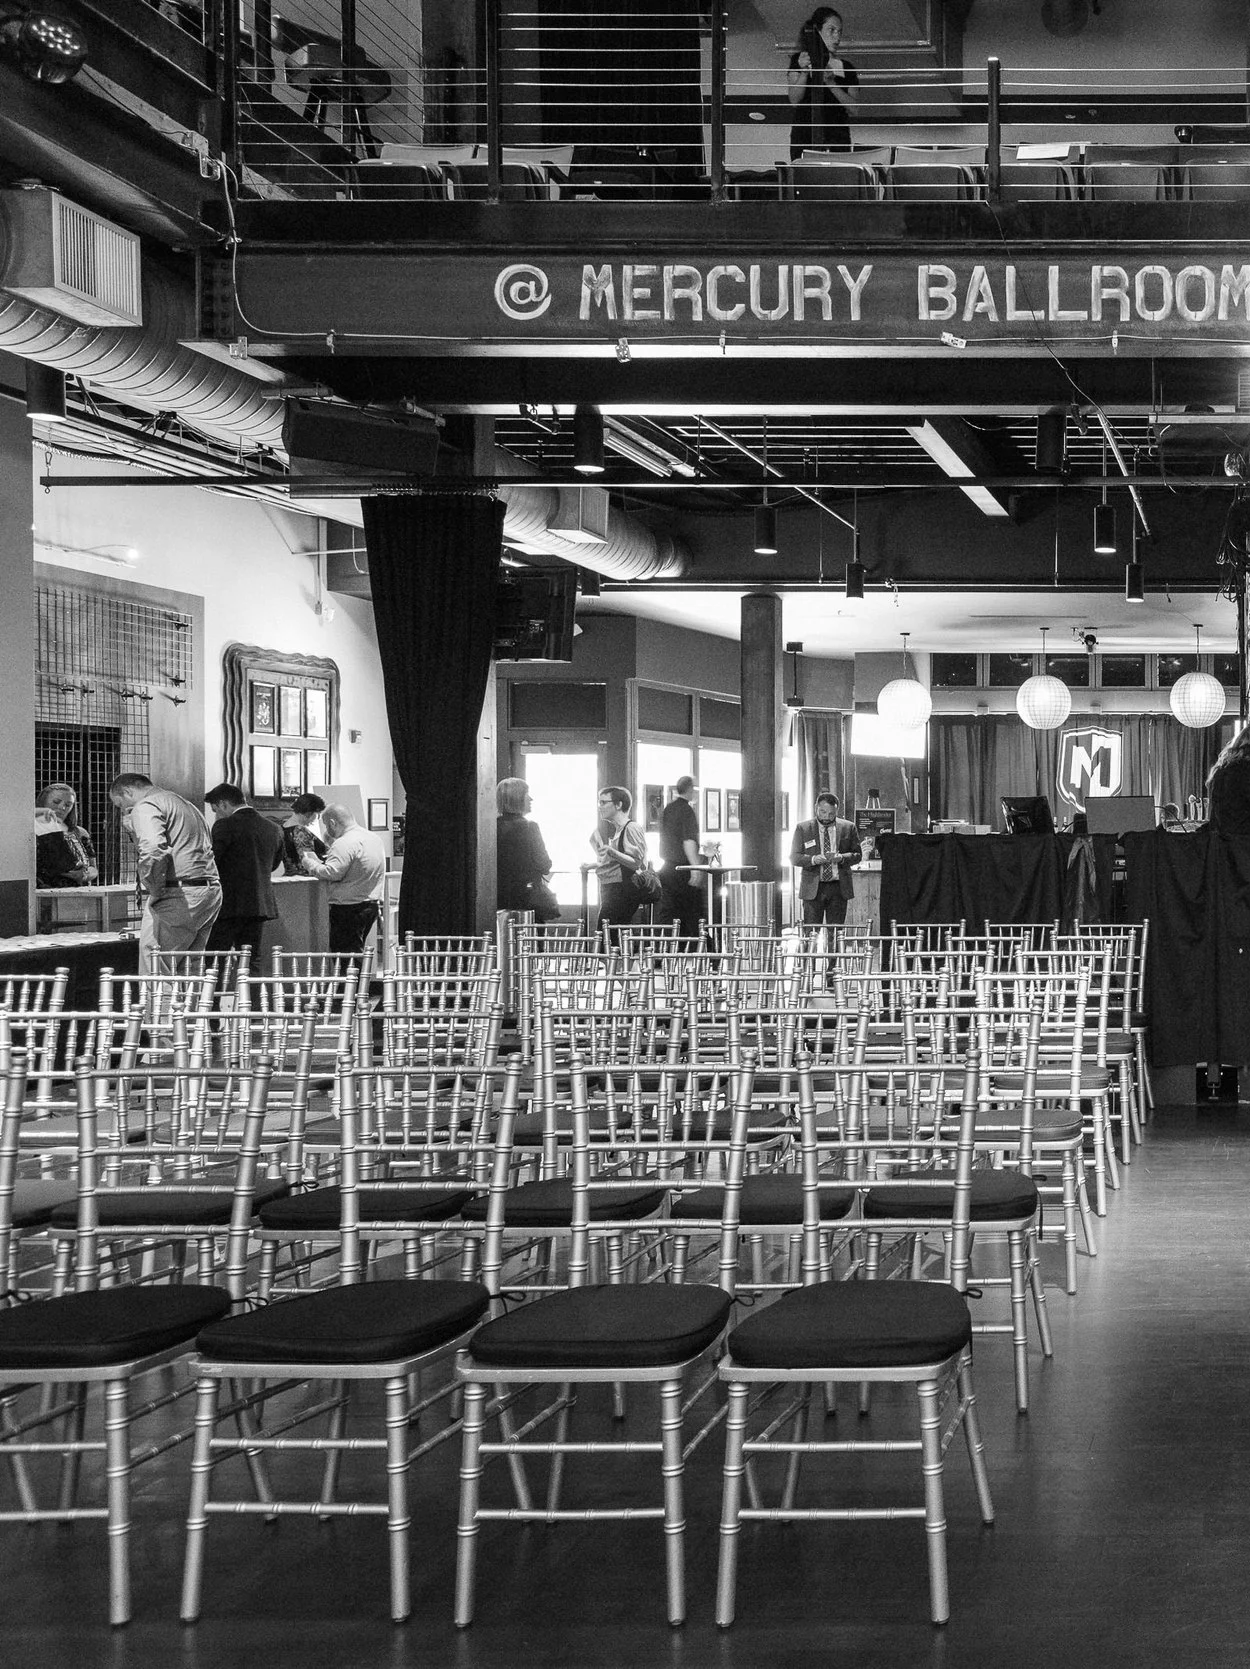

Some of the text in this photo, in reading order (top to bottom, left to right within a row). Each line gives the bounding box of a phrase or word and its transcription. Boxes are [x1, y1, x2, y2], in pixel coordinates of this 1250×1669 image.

[494, 263, 552, 320] @
[579, 264, 873, 321] MERCURY
[1070, 744, 1111, 789] M
